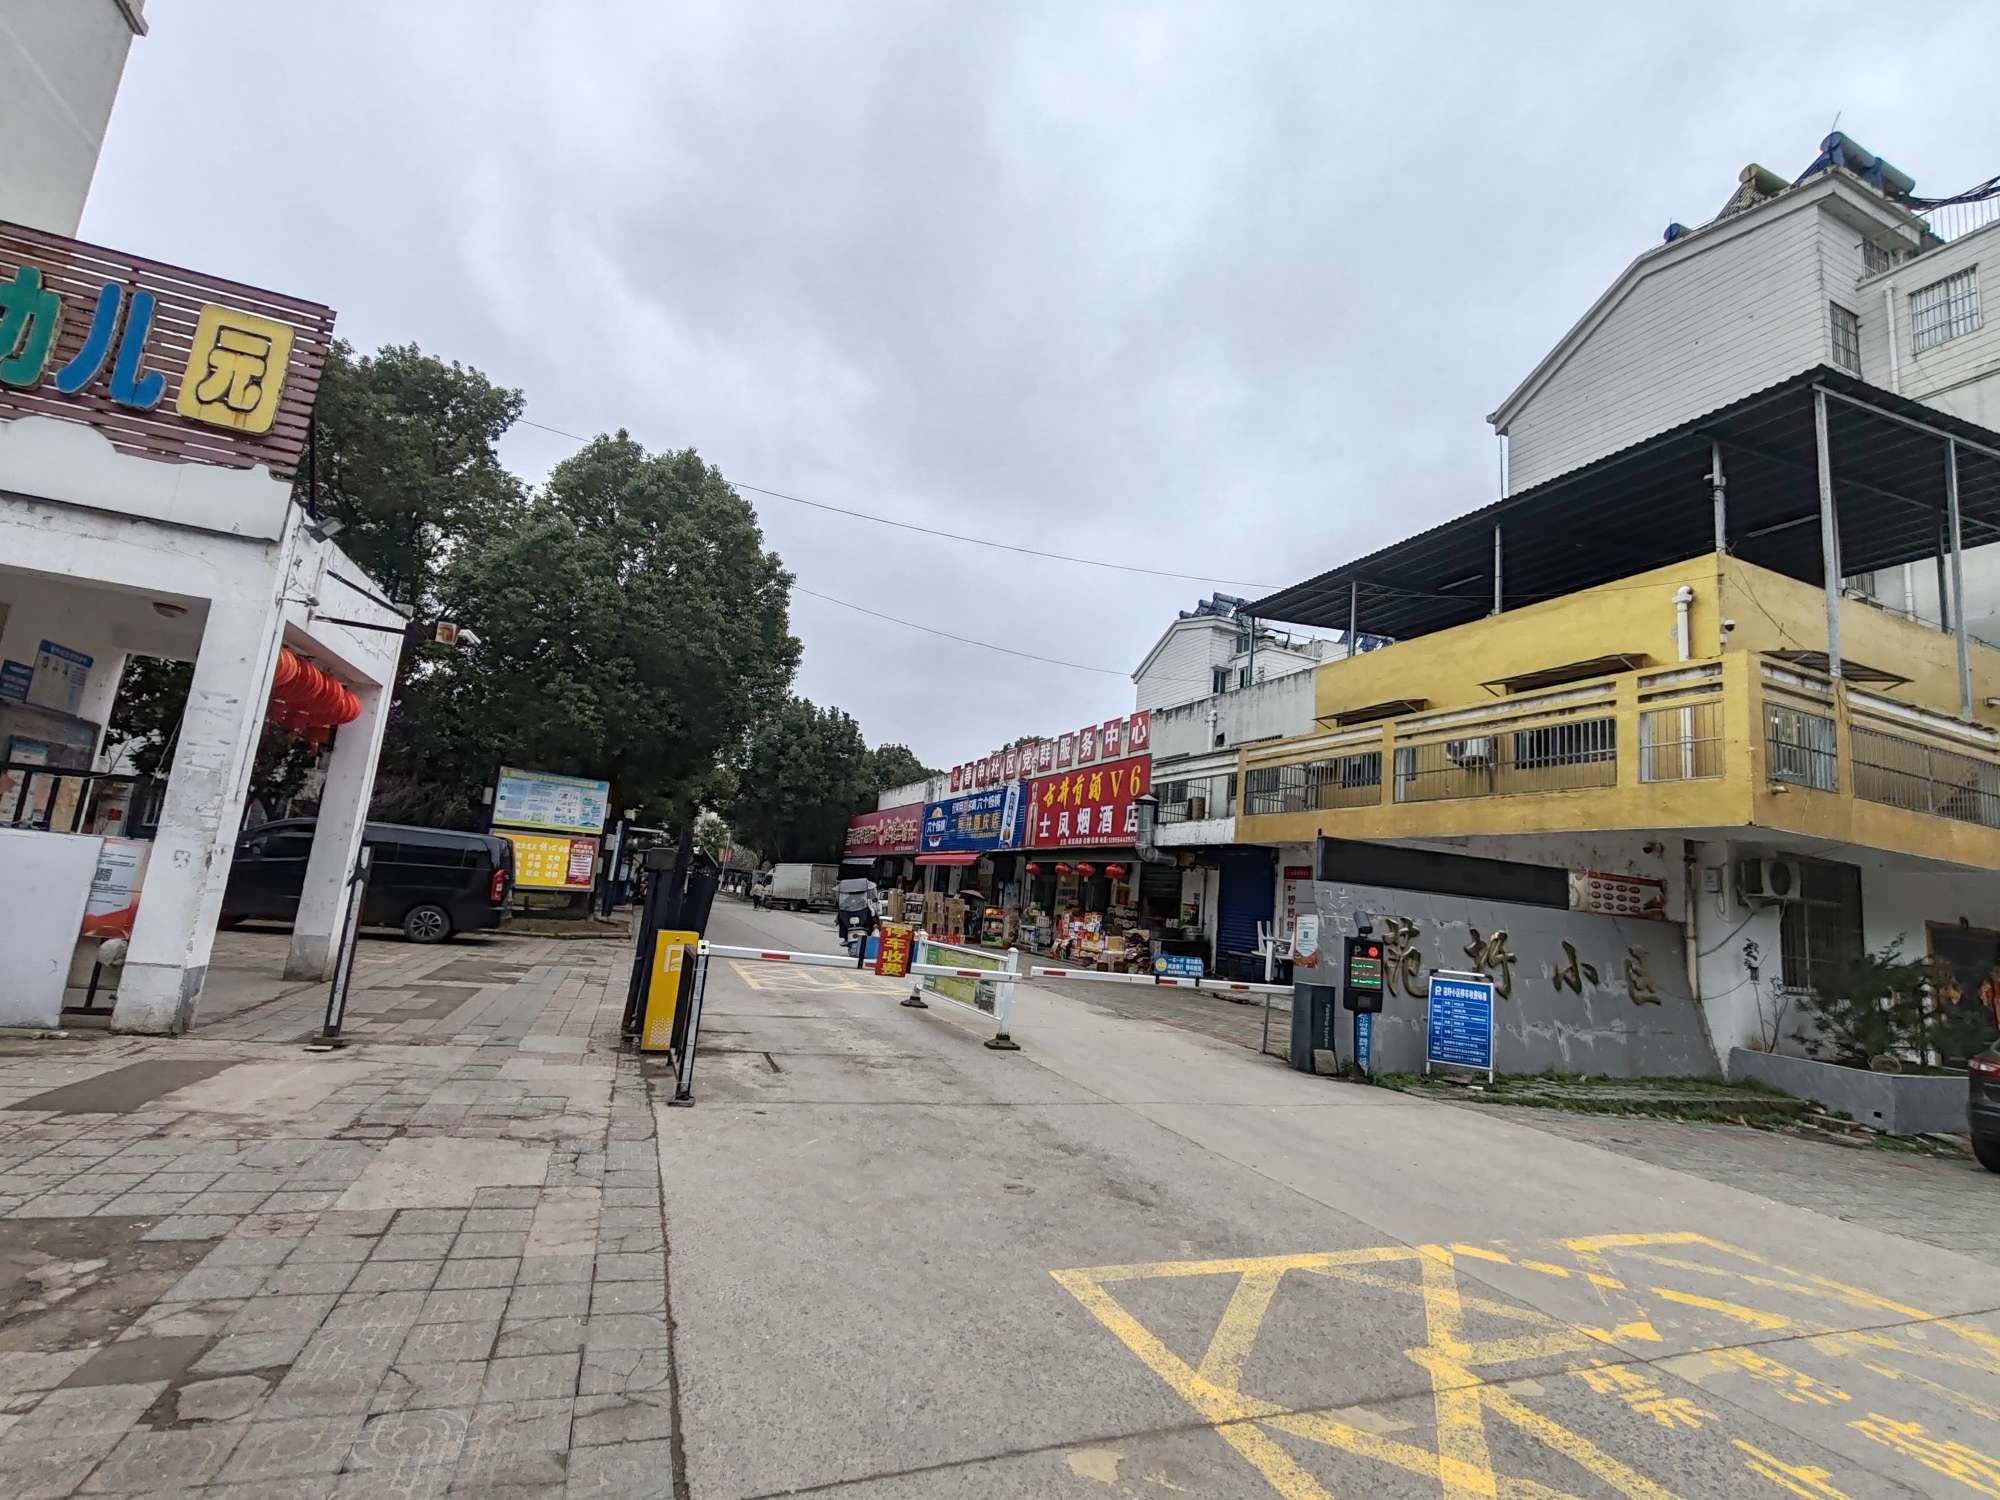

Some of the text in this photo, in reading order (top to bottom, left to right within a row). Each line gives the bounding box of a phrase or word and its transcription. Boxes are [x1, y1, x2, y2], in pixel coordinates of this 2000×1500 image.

[963, 717, 1147, 787] 春申社区党群服务中心
[1039, 801, 1139, 838] 士凤烟酒店
[881, 926, 909, 977] 停车收费
